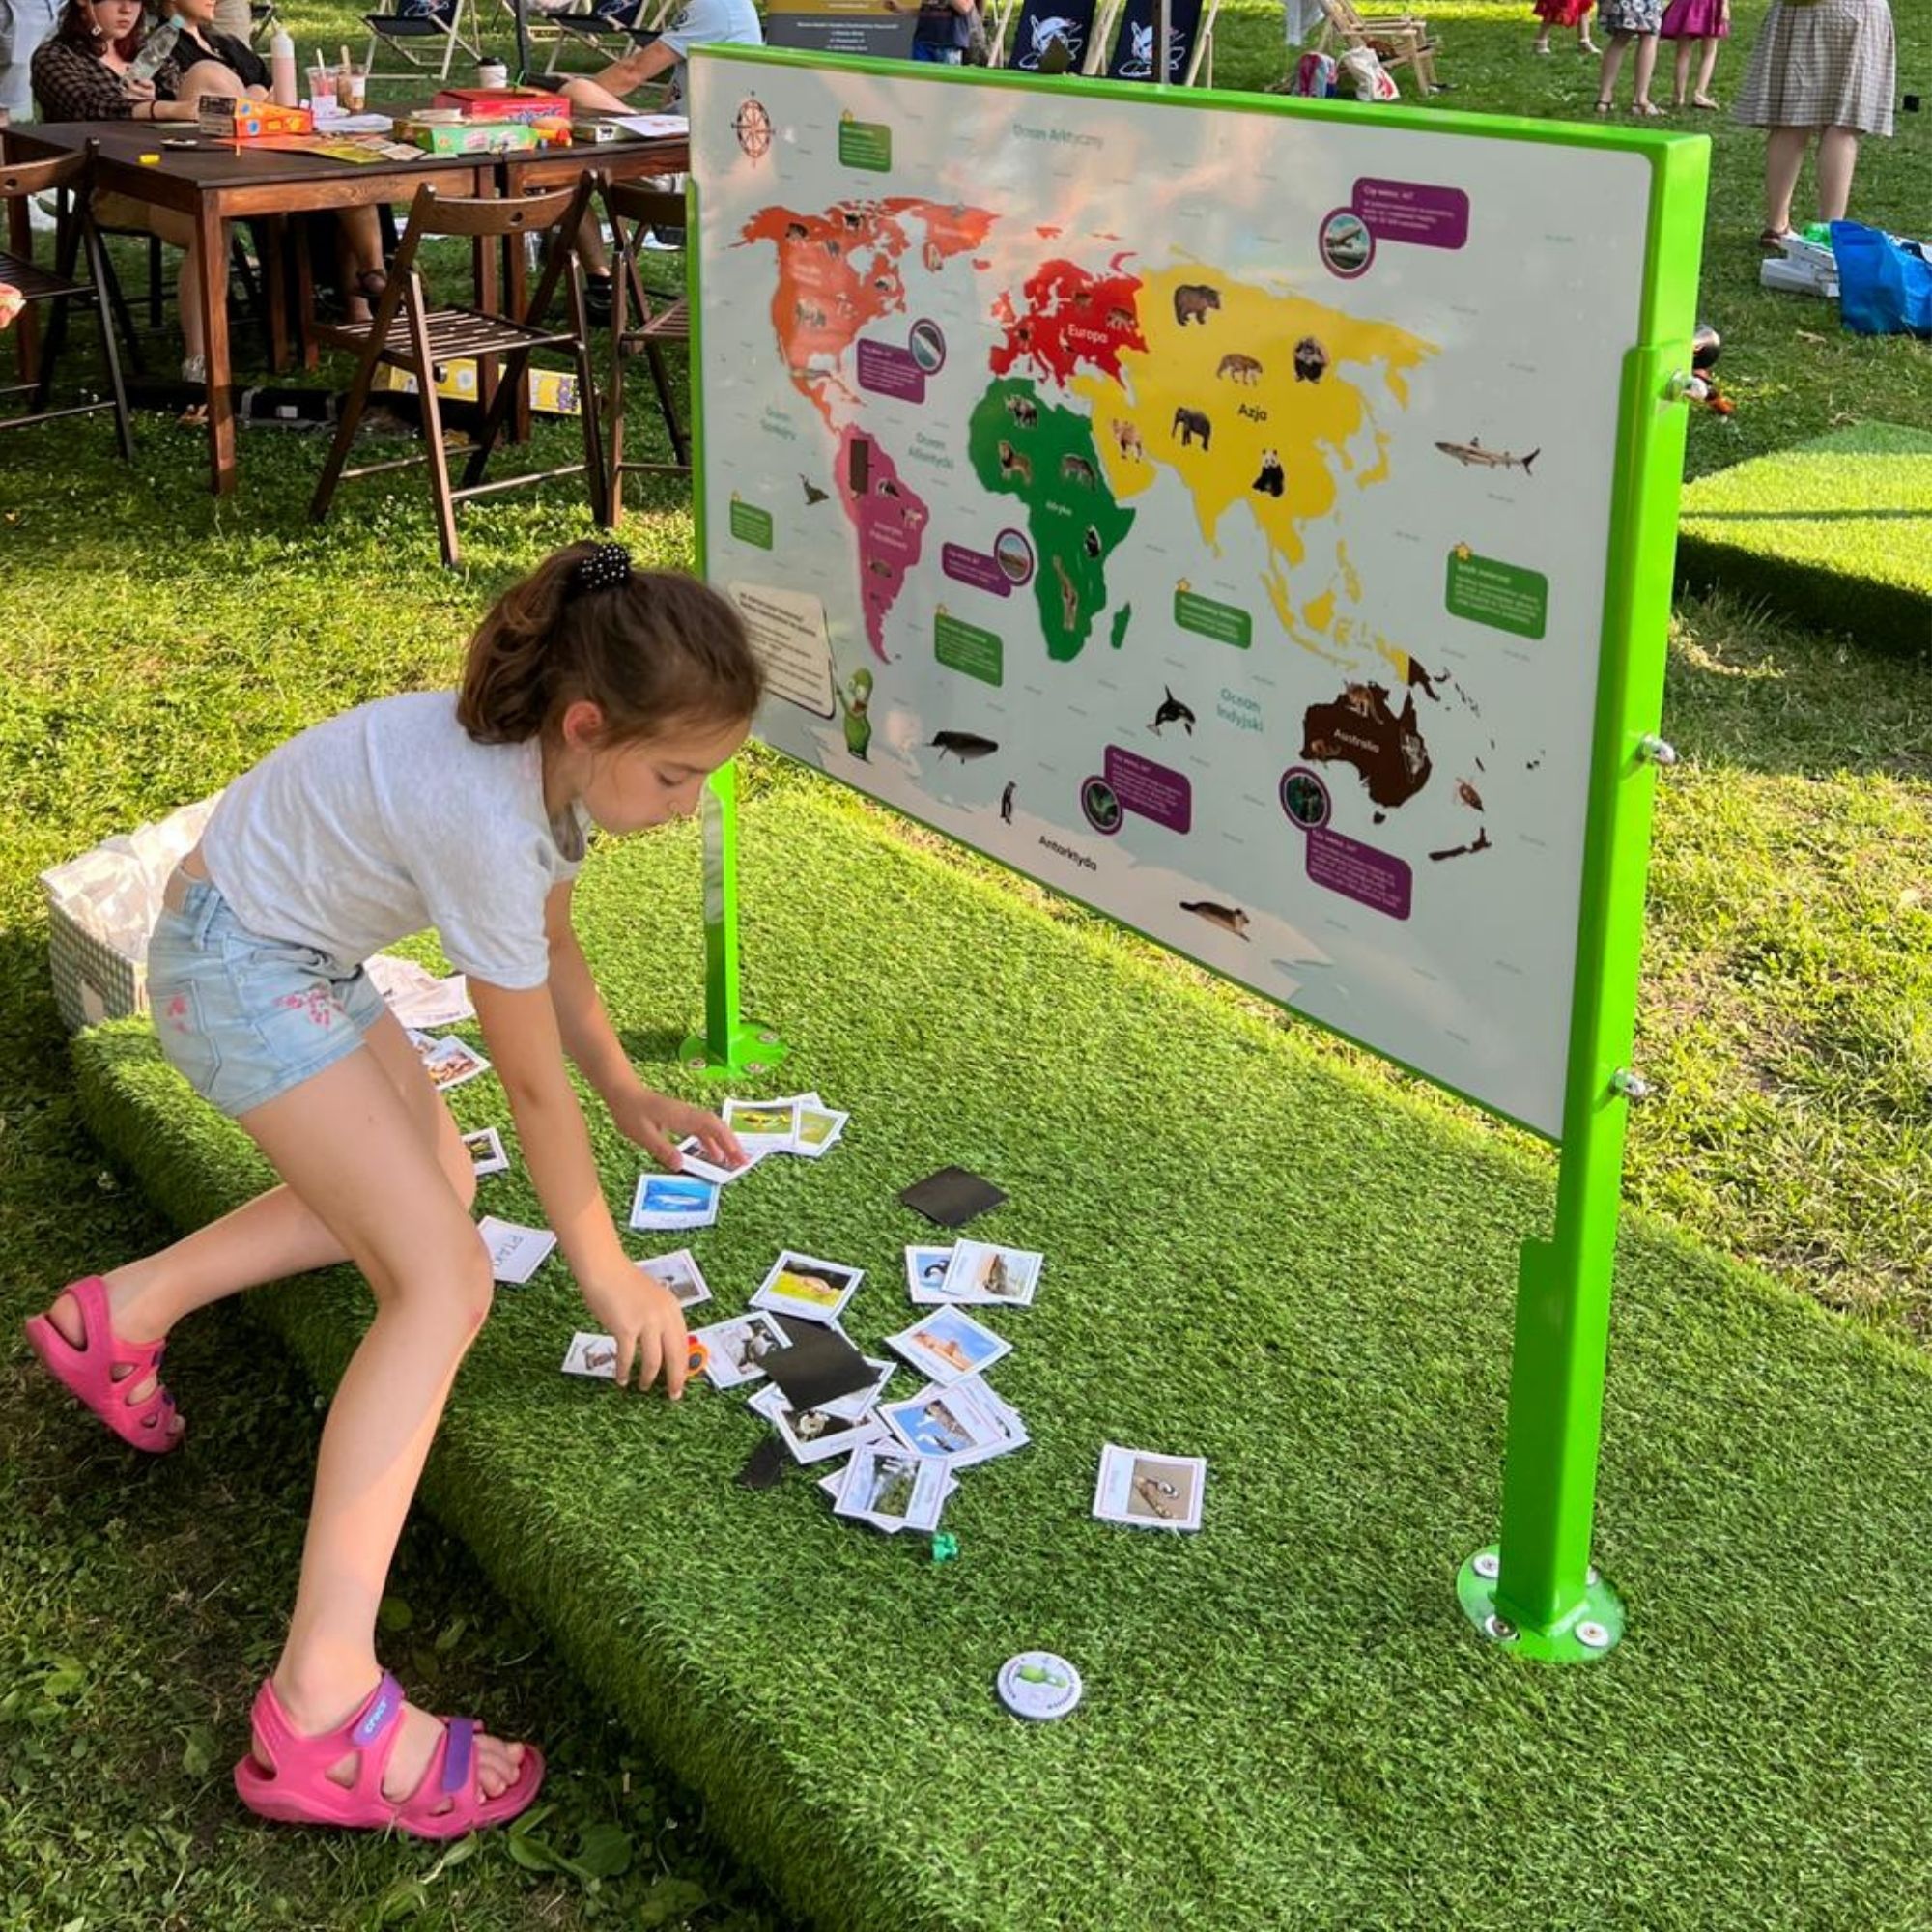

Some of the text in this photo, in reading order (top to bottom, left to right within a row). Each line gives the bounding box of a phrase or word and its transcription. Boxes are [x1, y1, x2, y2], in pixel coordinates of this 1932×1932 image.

[1067, 323, 1109, 344] Europa
[1237, 402, 1267, 423] Azja
[1220, 687, 1261, 715] Ocean
[1216, 703, 1264, 733] Indyjski
[1333, 728, 1380, 753] Australia
[1037, 835, 1097, 871] Antarktyda
